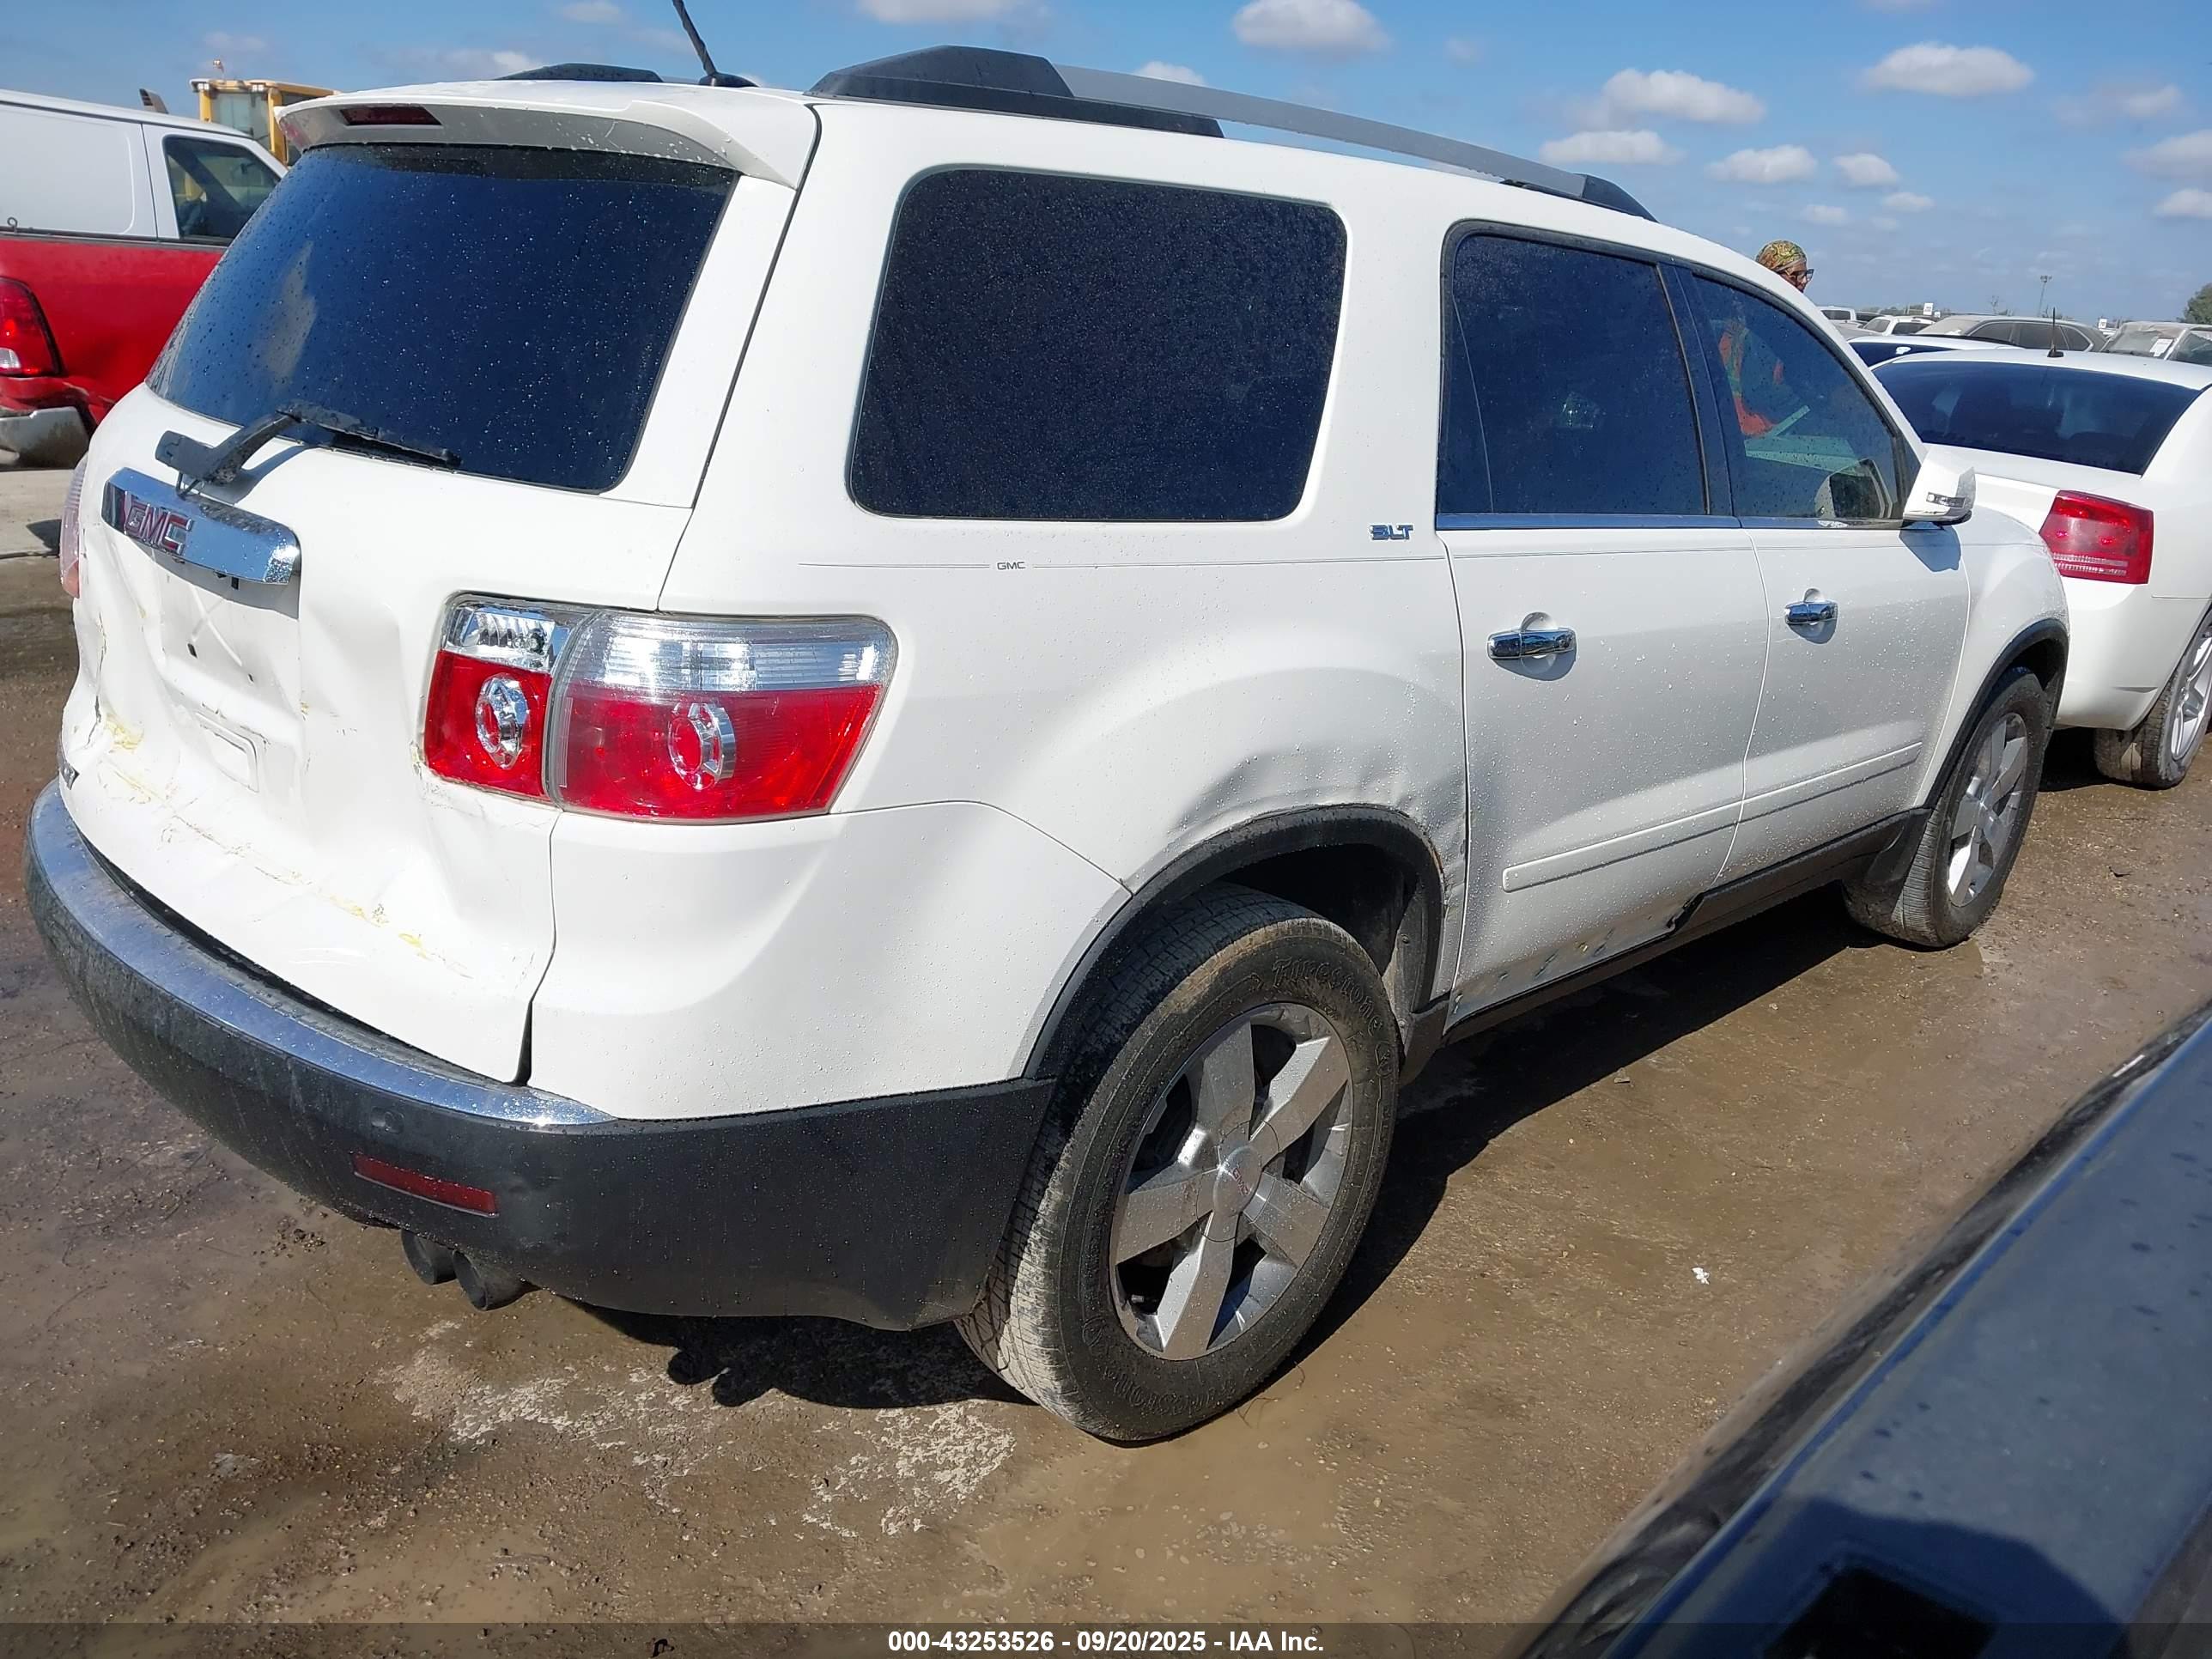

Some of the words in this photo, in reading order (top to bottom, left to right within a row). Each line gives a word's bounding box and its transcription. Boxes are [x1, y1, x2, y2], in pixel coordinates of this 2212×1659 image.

[123, 490, 193, 556] GMC
[1369, 524, 1413, 540] SLT
[997, 561, 1026, 570] GMC
